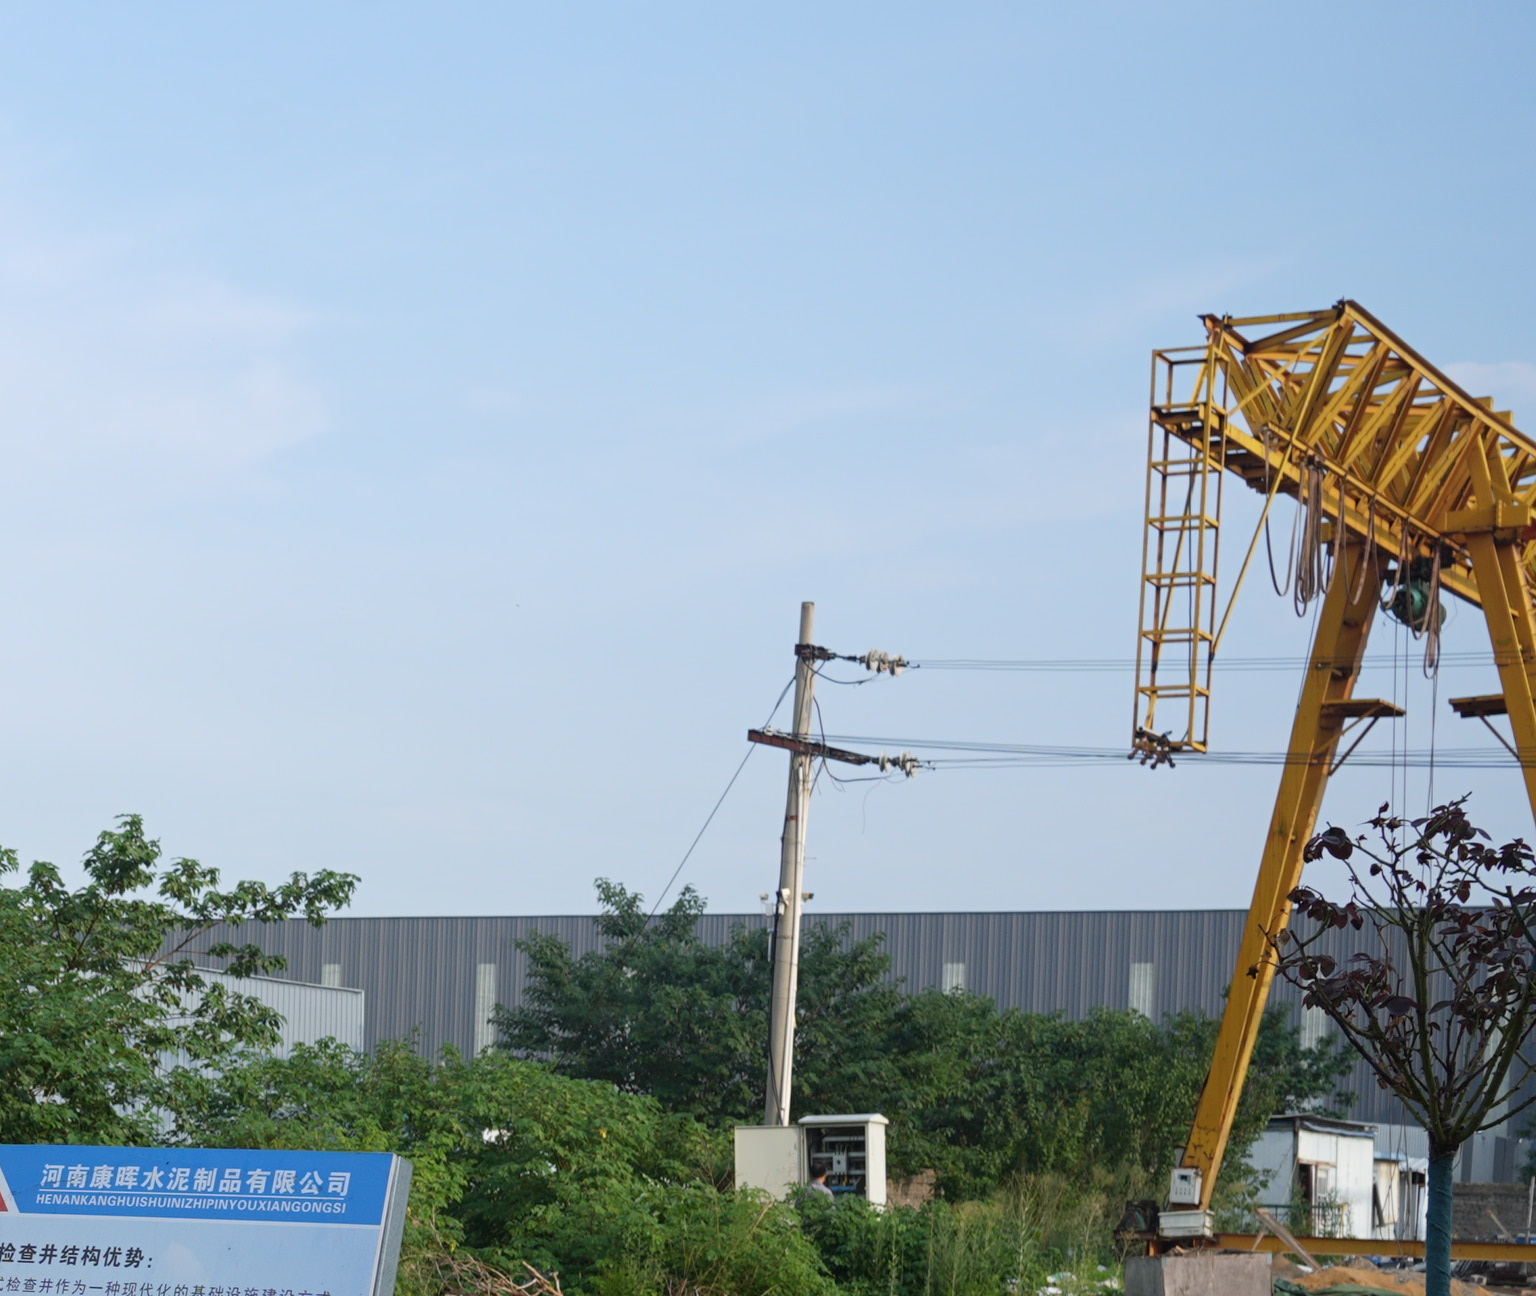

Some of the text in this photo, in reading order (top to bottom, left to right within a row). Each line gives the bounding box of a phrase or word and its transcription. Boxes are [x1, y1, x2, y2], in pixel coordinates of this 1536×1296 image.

[40, 1163, 352, 1196] 河南康晖水泥制品有限公司
[36, 1194, 346, 1213] HENANKANGHUISHUINIZHIPINYOUXIANGONGSI
